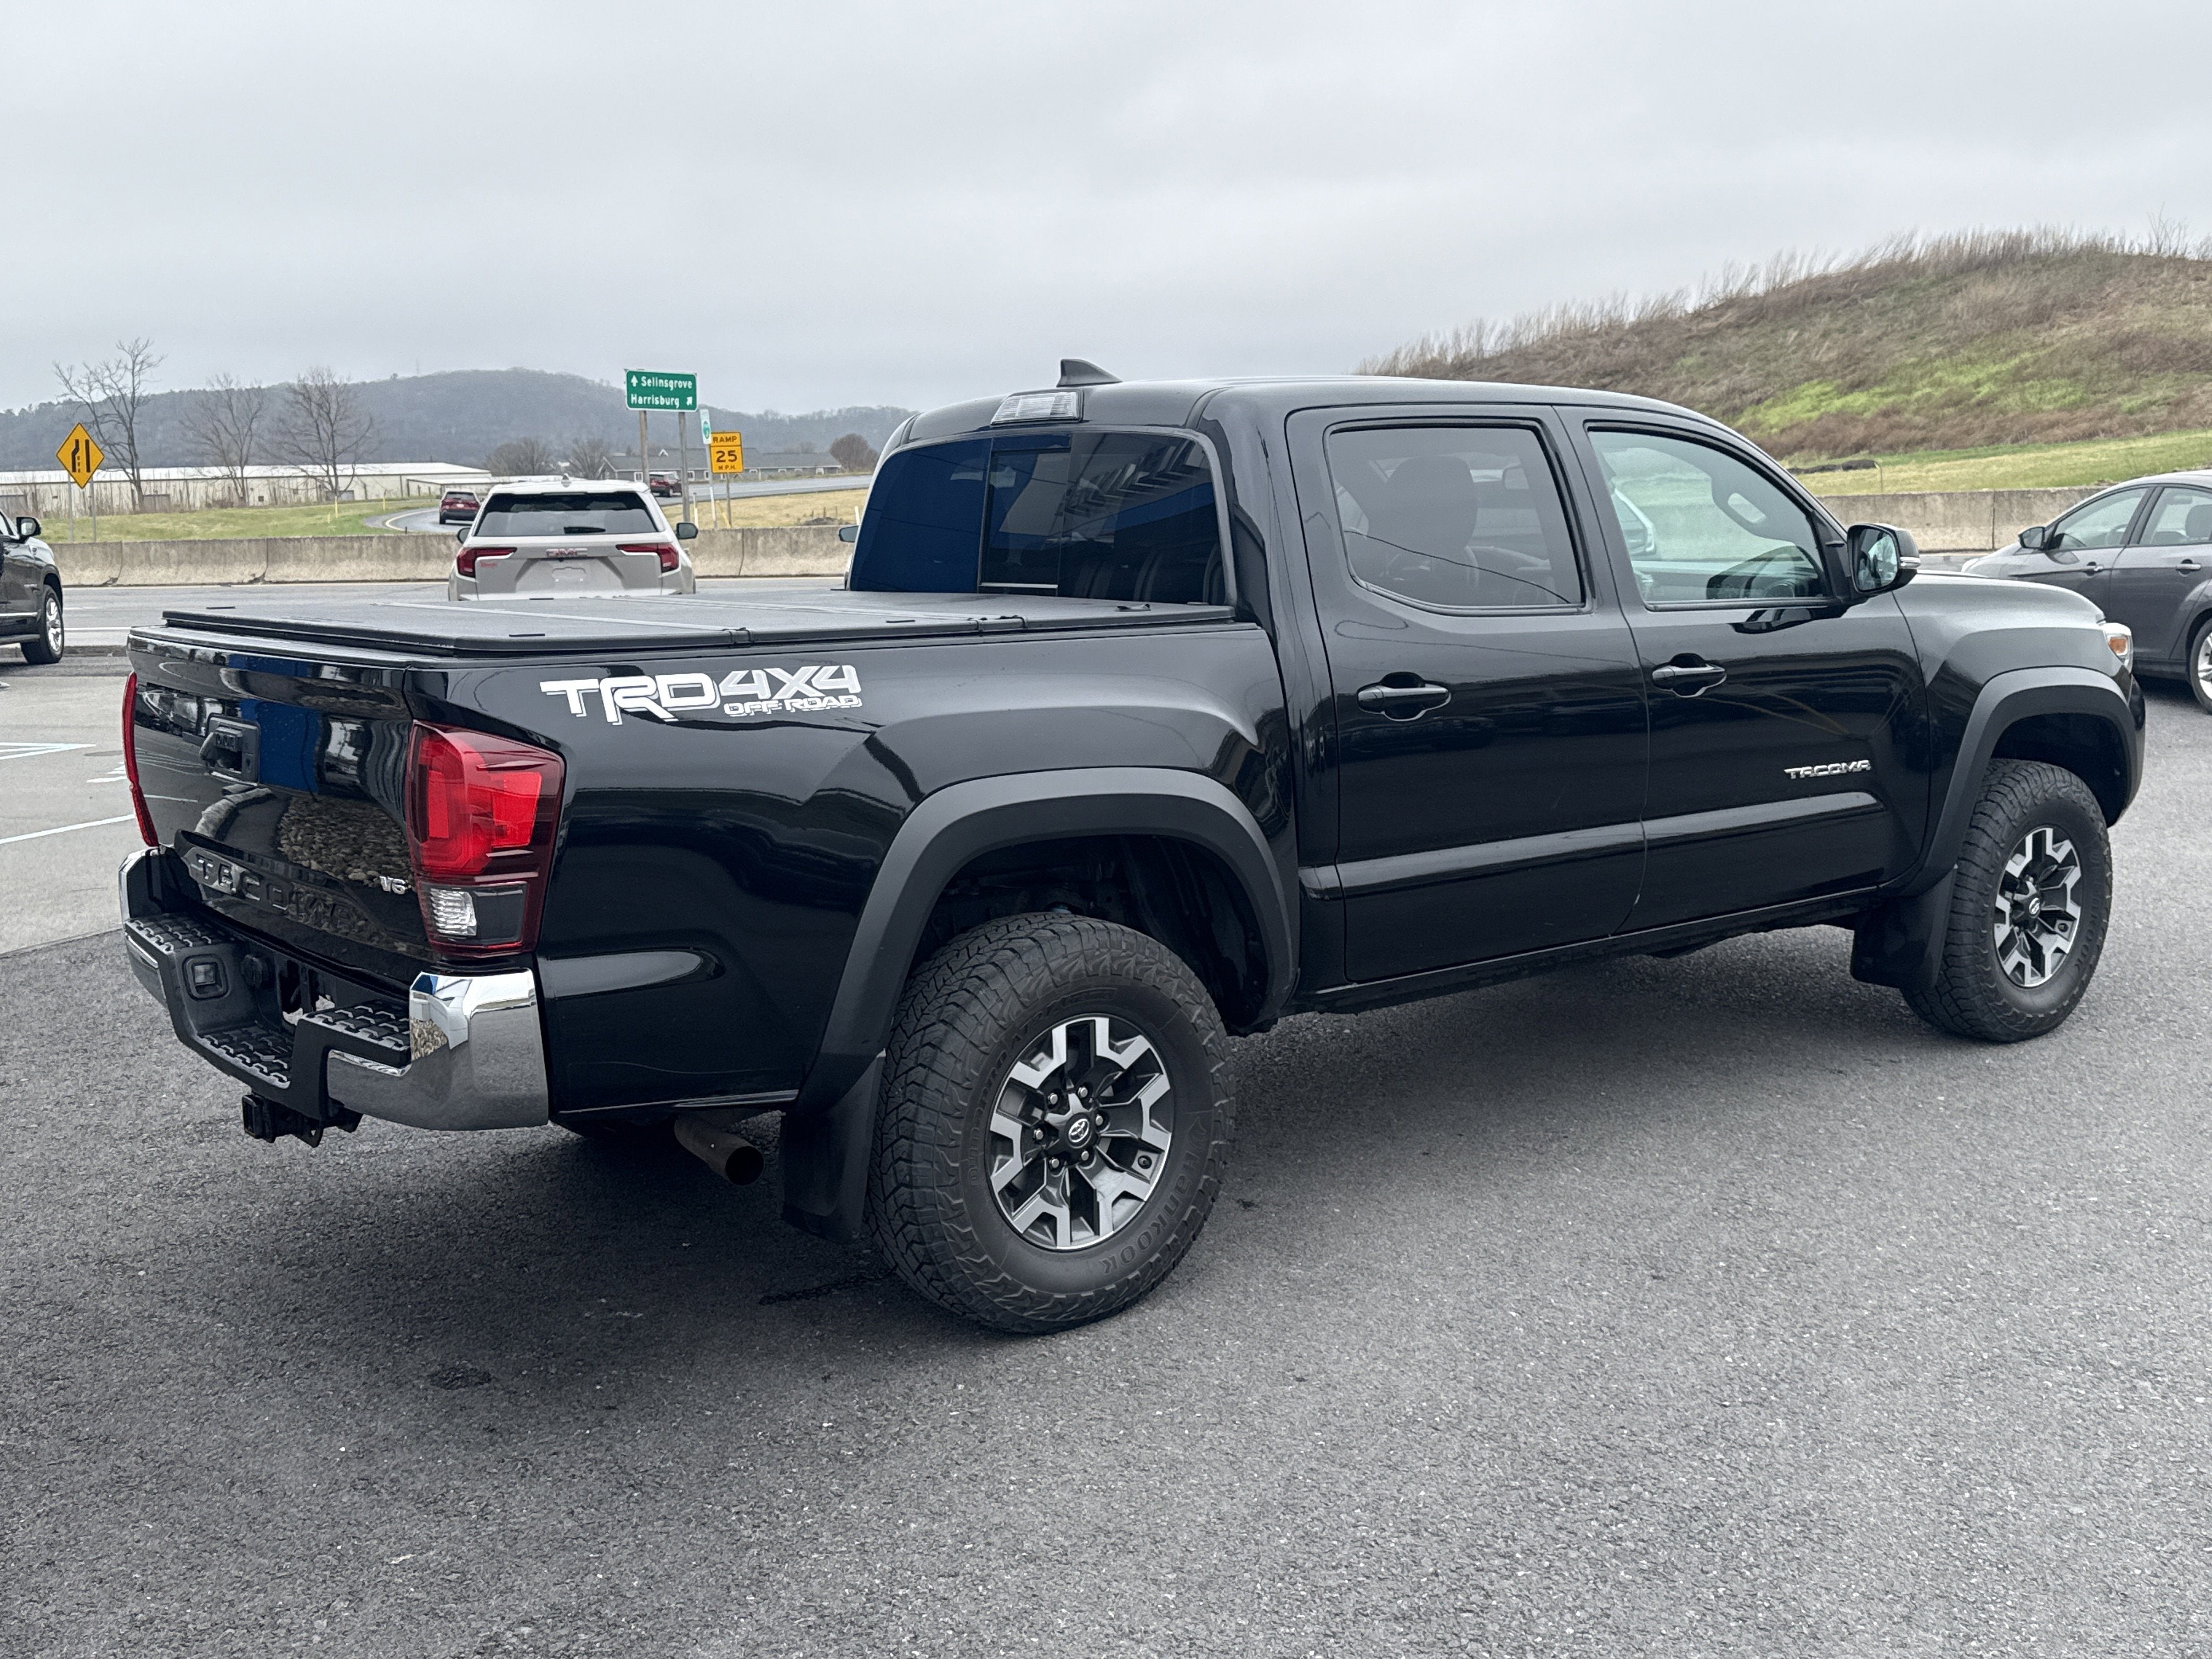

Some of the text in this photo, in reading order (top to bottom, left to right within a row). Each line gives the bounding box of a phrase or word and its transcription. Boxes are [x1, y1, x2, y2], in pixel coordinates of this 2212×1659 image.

[641, 376, 692, 391] Selinsgrove
[630, 393, 679, 409] Harrisburg
[716, 450, 737, 462] 25
[540, 673, 720, 725] TRD
[724, 695, 862, 717] OFF ROAD
[1784, 760, 1871, 780] TACOMA
[380, 875, 410, 895] V6
